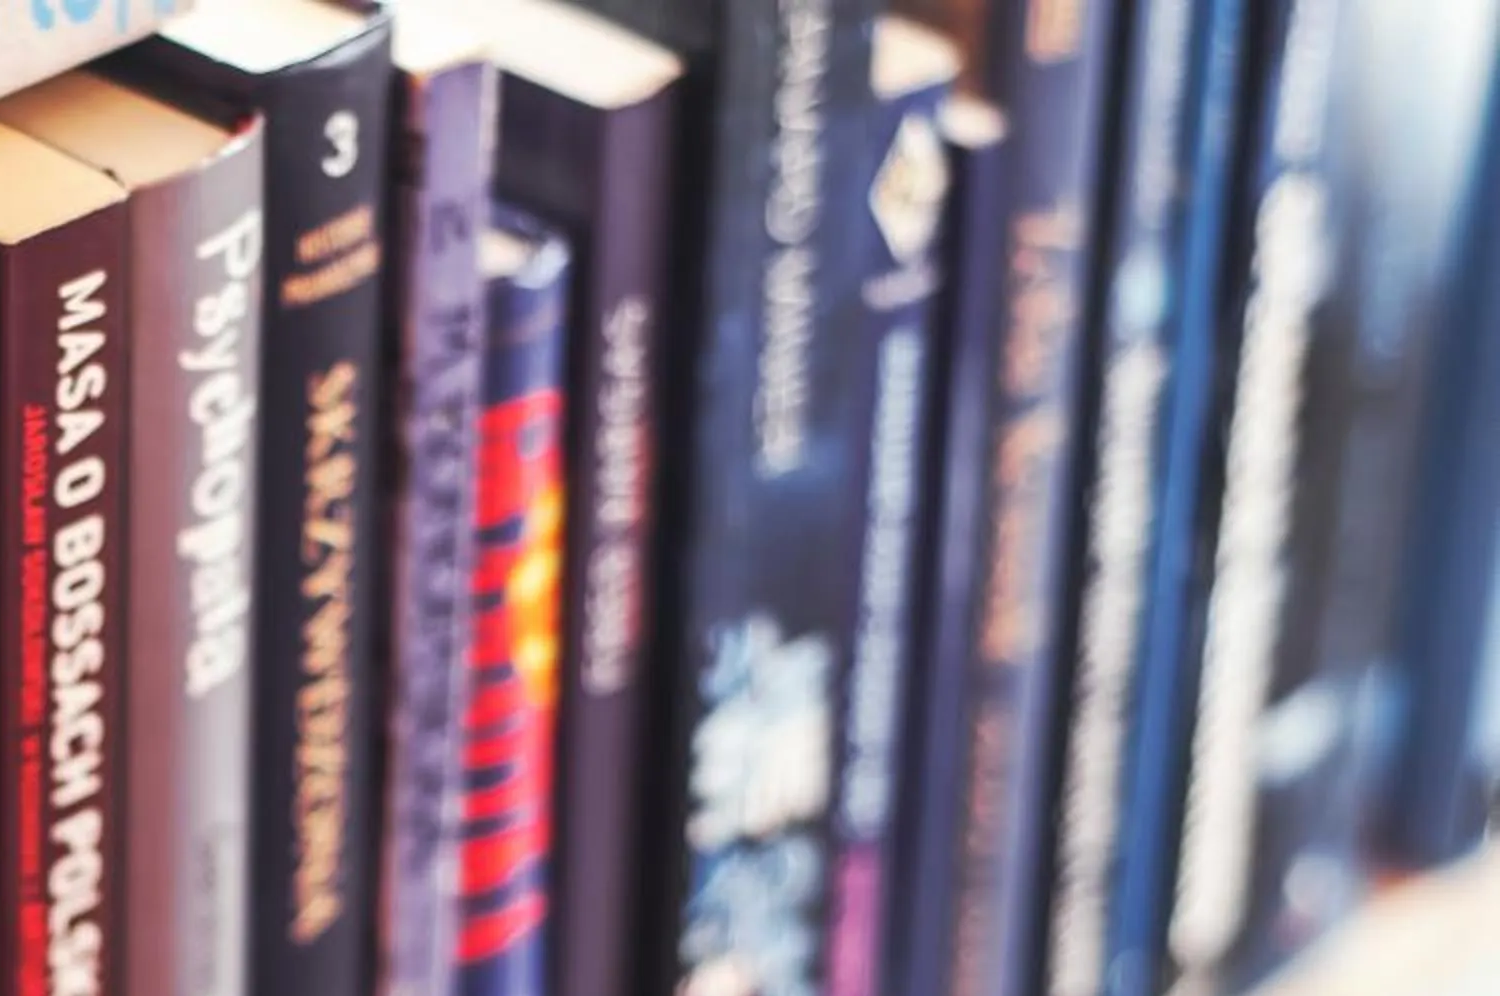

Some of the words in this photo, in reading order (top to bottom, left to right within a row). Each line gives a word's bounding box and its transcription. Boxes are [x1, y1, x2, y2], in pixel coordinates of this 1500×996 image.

[320, 111, 359, 178] 3
[56, 269, 108, 455] MASA
[54, 457, 105, 508] O
[49, 514, 105, 807] BOSSACH
